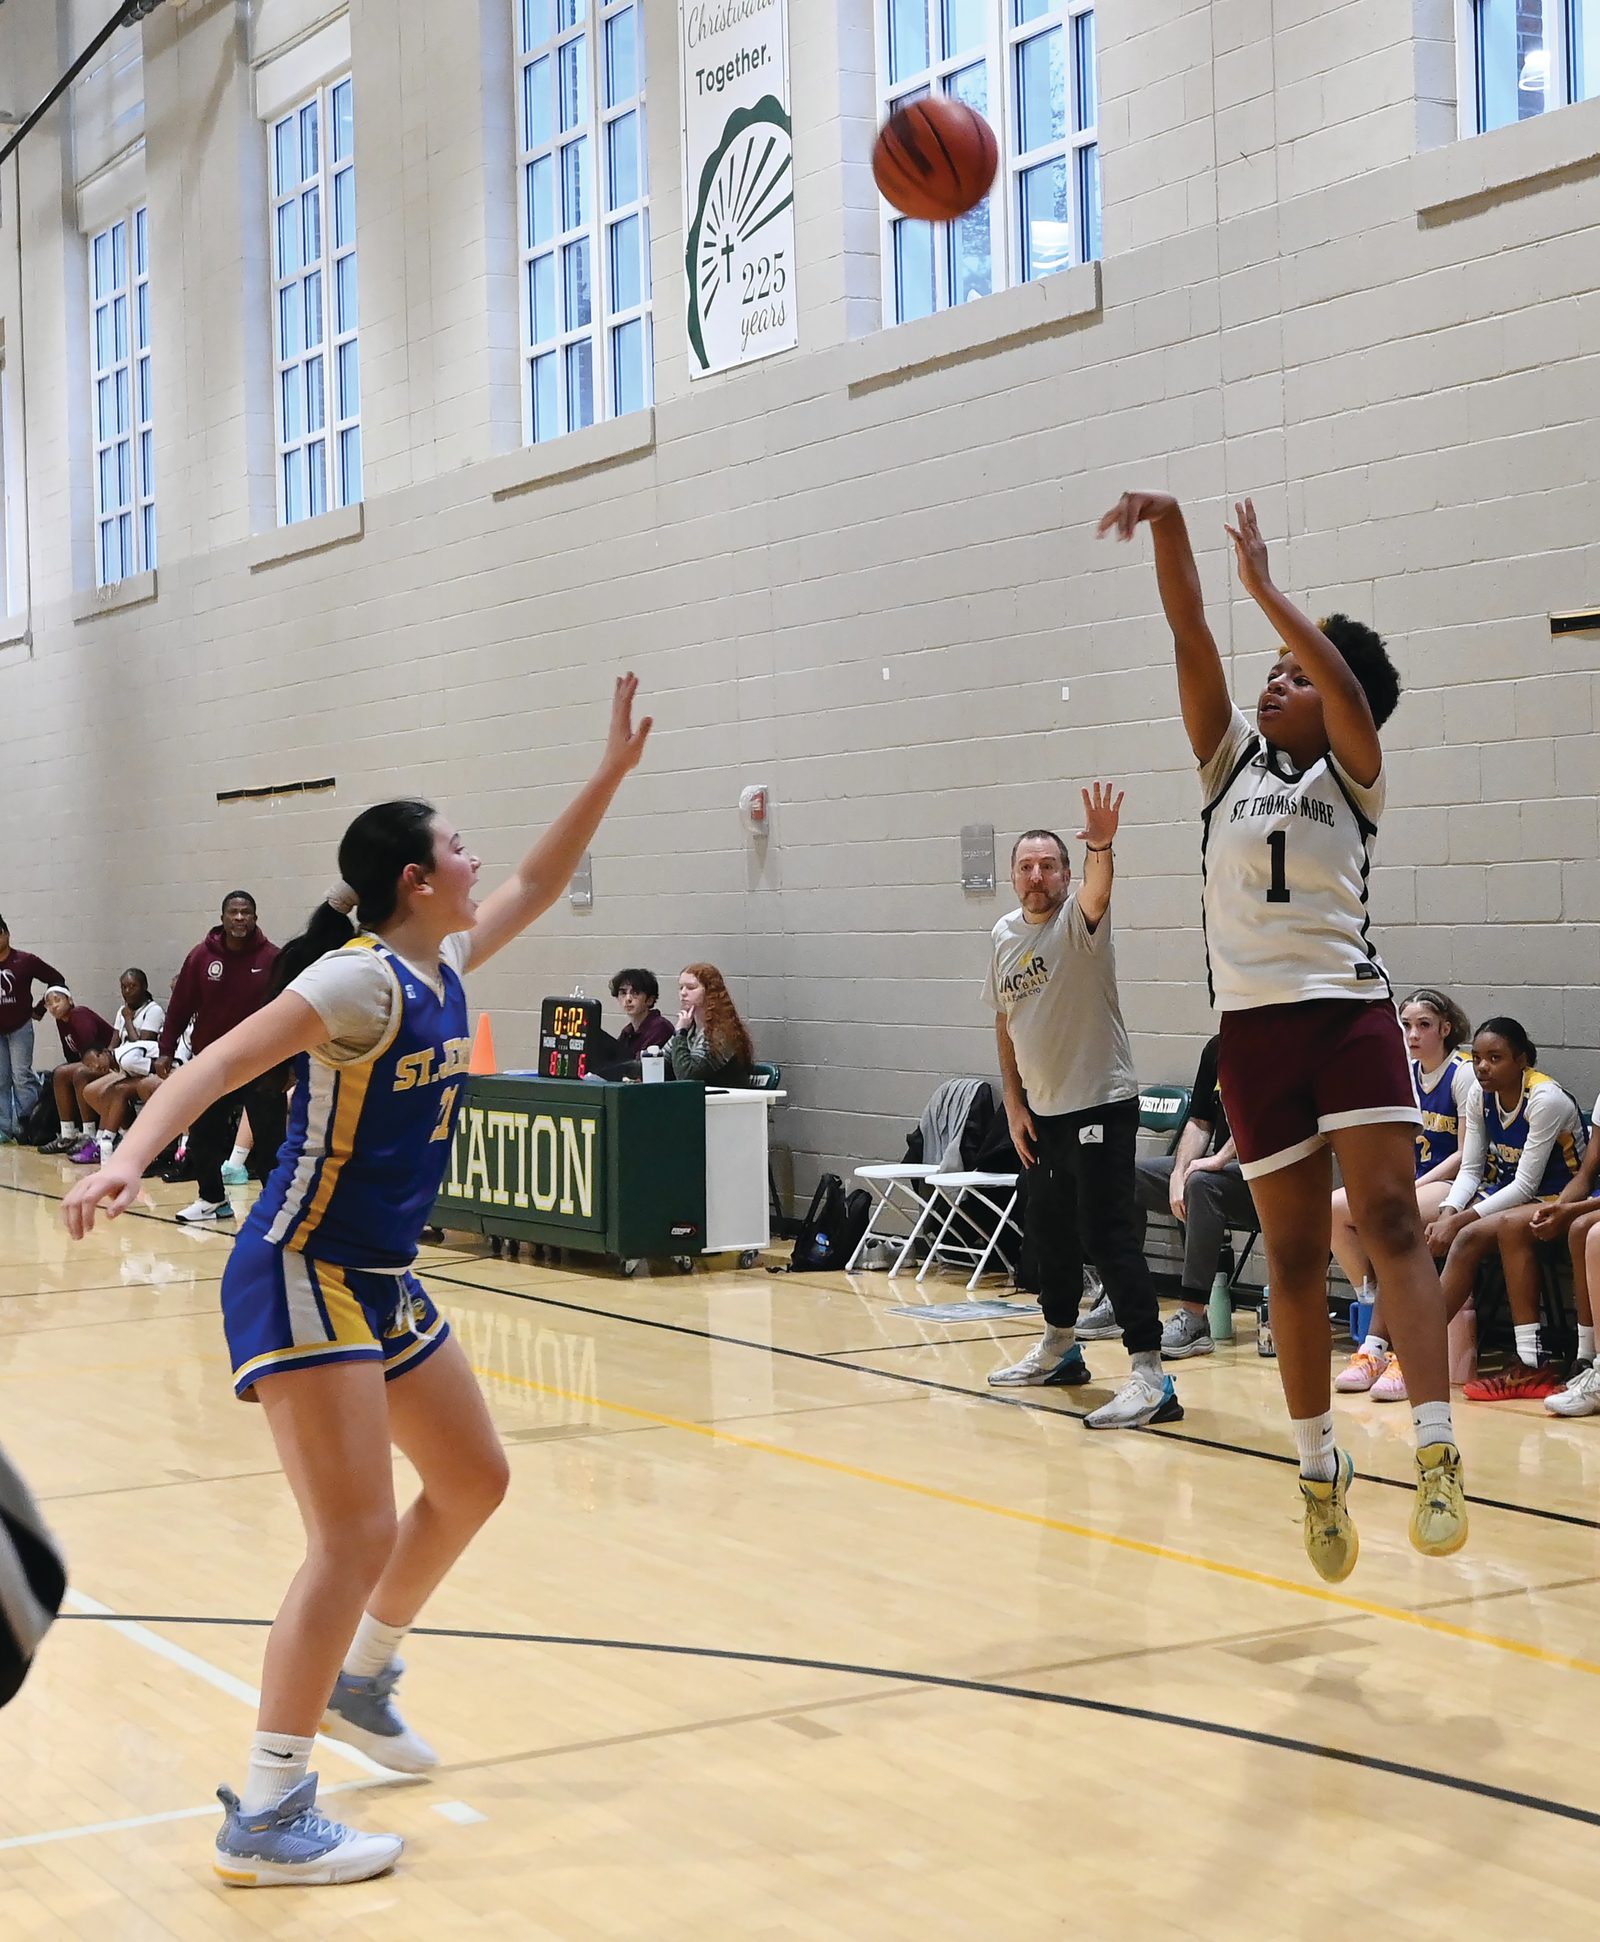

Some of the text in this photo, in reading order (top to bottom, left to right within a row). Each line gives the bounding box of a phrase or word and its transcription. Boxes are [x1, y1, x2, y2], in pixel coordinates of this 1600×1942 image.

[695, 43, 772, 96] Together.
[742, 249, 786, 305] 225
[741, 300, 786, 352] years
[1230, 794, 1335, 828] ST. THOMAS MORE
[1266, 830, 1291, 903] 1
[554, 1006, 584, 1037] 0:02
[1415, 1135, 1432, 1163] 2
